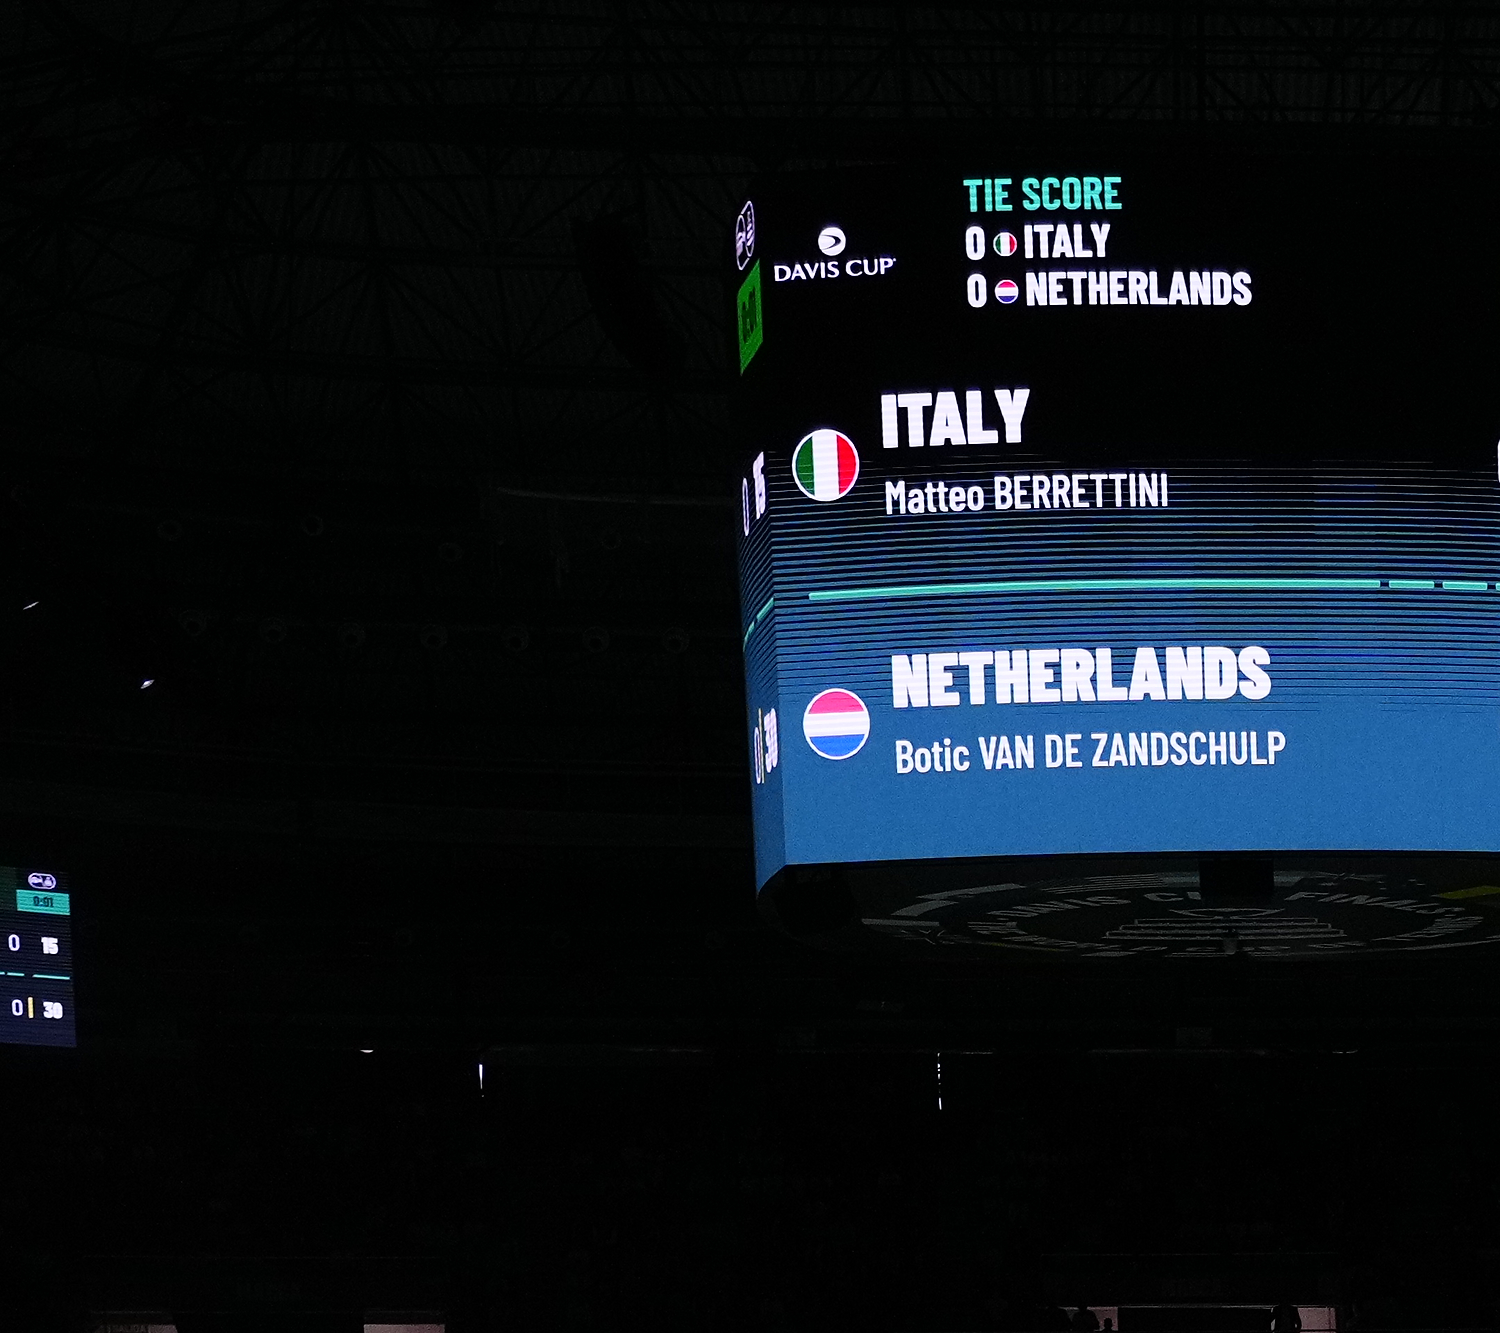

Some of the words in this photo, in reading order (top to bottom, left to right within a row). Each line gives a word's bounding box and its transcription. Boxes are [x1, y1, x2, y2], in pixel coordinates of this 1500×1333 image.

[963, 178, 1013, 211] TIE
[1022, 176, 1123, 210] SCORE
[965, 226, 985, 260] 0
[1024, 223, 1110, 258] ITALY
[774, 261, 840, 282] DAVIS
[845, 258, 896, 277] CUP
[967, 273, 987, 308] 0
[1026, 271, 1252, 306] NETHERLANDS
[881, 388, 1030, 449] ITALY
[885, 480, 984, 515] Matteo
[994, 473, 1169, 510] BERRETTINI
[891, 646, 1272, 708] NETHERLANDS
[895, 738, 970, 774] Botic
[978, 735, 1035, 770] VAN
[1045, 733, 1083, 769] DE
[1091, 730, 1286, 768] ZANDSCHULP
[8, 934, 20, 951] 0
[40, 937, 58, 955] 15
[11, 999, 23, 1016] 0
[43, 1001, 63, 1020] 30
